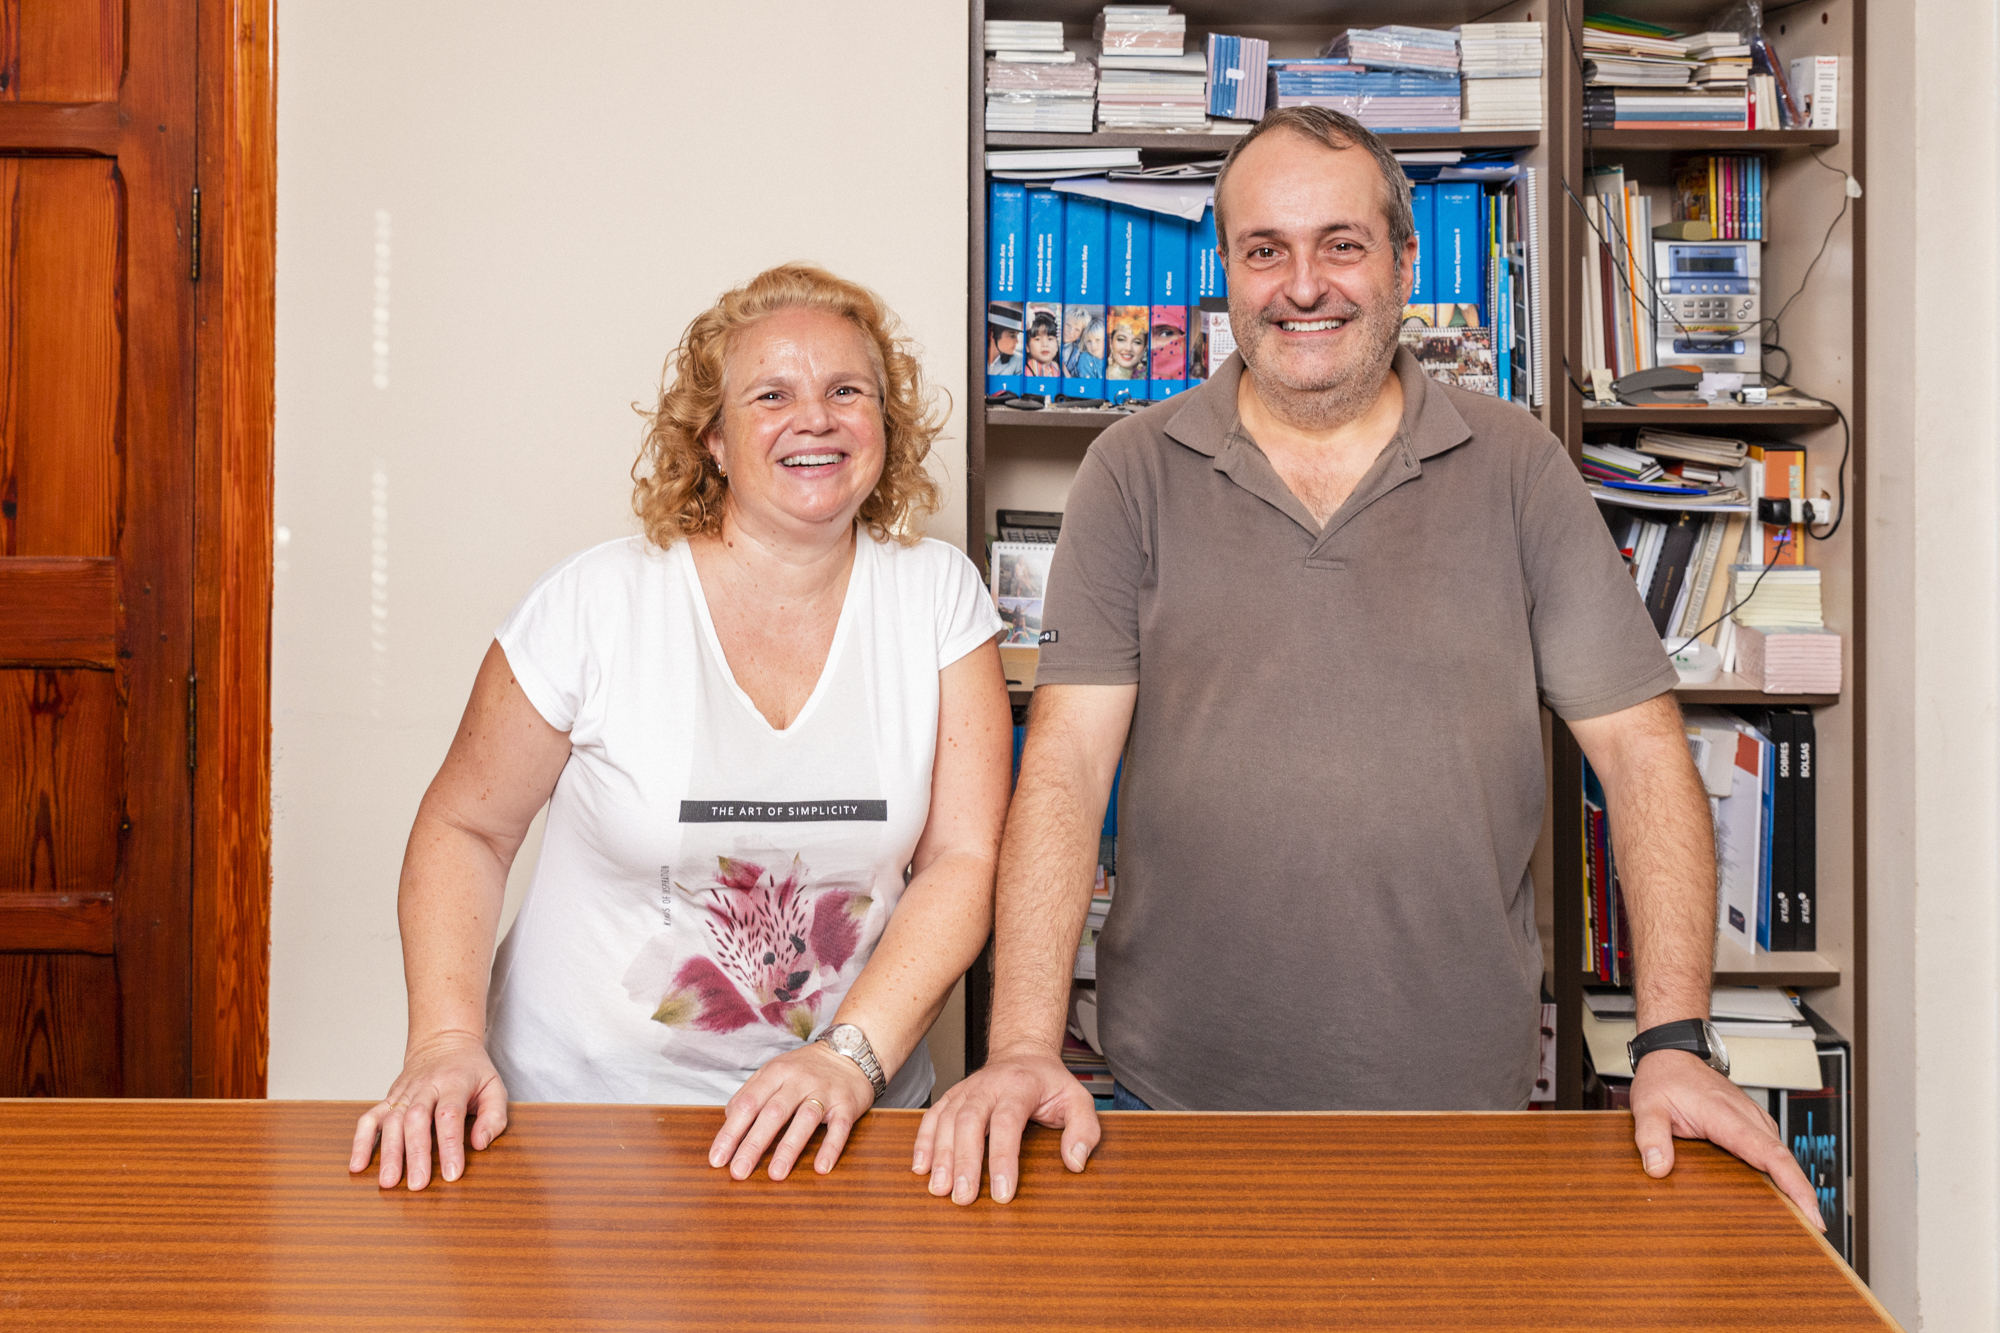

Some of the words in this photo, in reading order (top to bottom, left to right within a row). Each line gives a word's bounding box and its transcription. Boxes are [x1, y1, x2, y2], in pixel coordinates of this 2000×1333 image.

[1454, 265, 1462, 288] Papeles
[1039, 384, 1045, 392] 2
[1079, 386, 1085, 394] 3
[1165, 387, 1171, 395] 5
[1780, 741, 1789, 778] SOBRES
[1800, 742, 1810, 778] BOLSAS
[711, 806, 734, 816] THE
[739, 806, 763, 816] ART
[767, 806, 784, 816] OF
[788, 805, 858, 816] SIMPLICITY
[662, 896, 671, 904] OF
